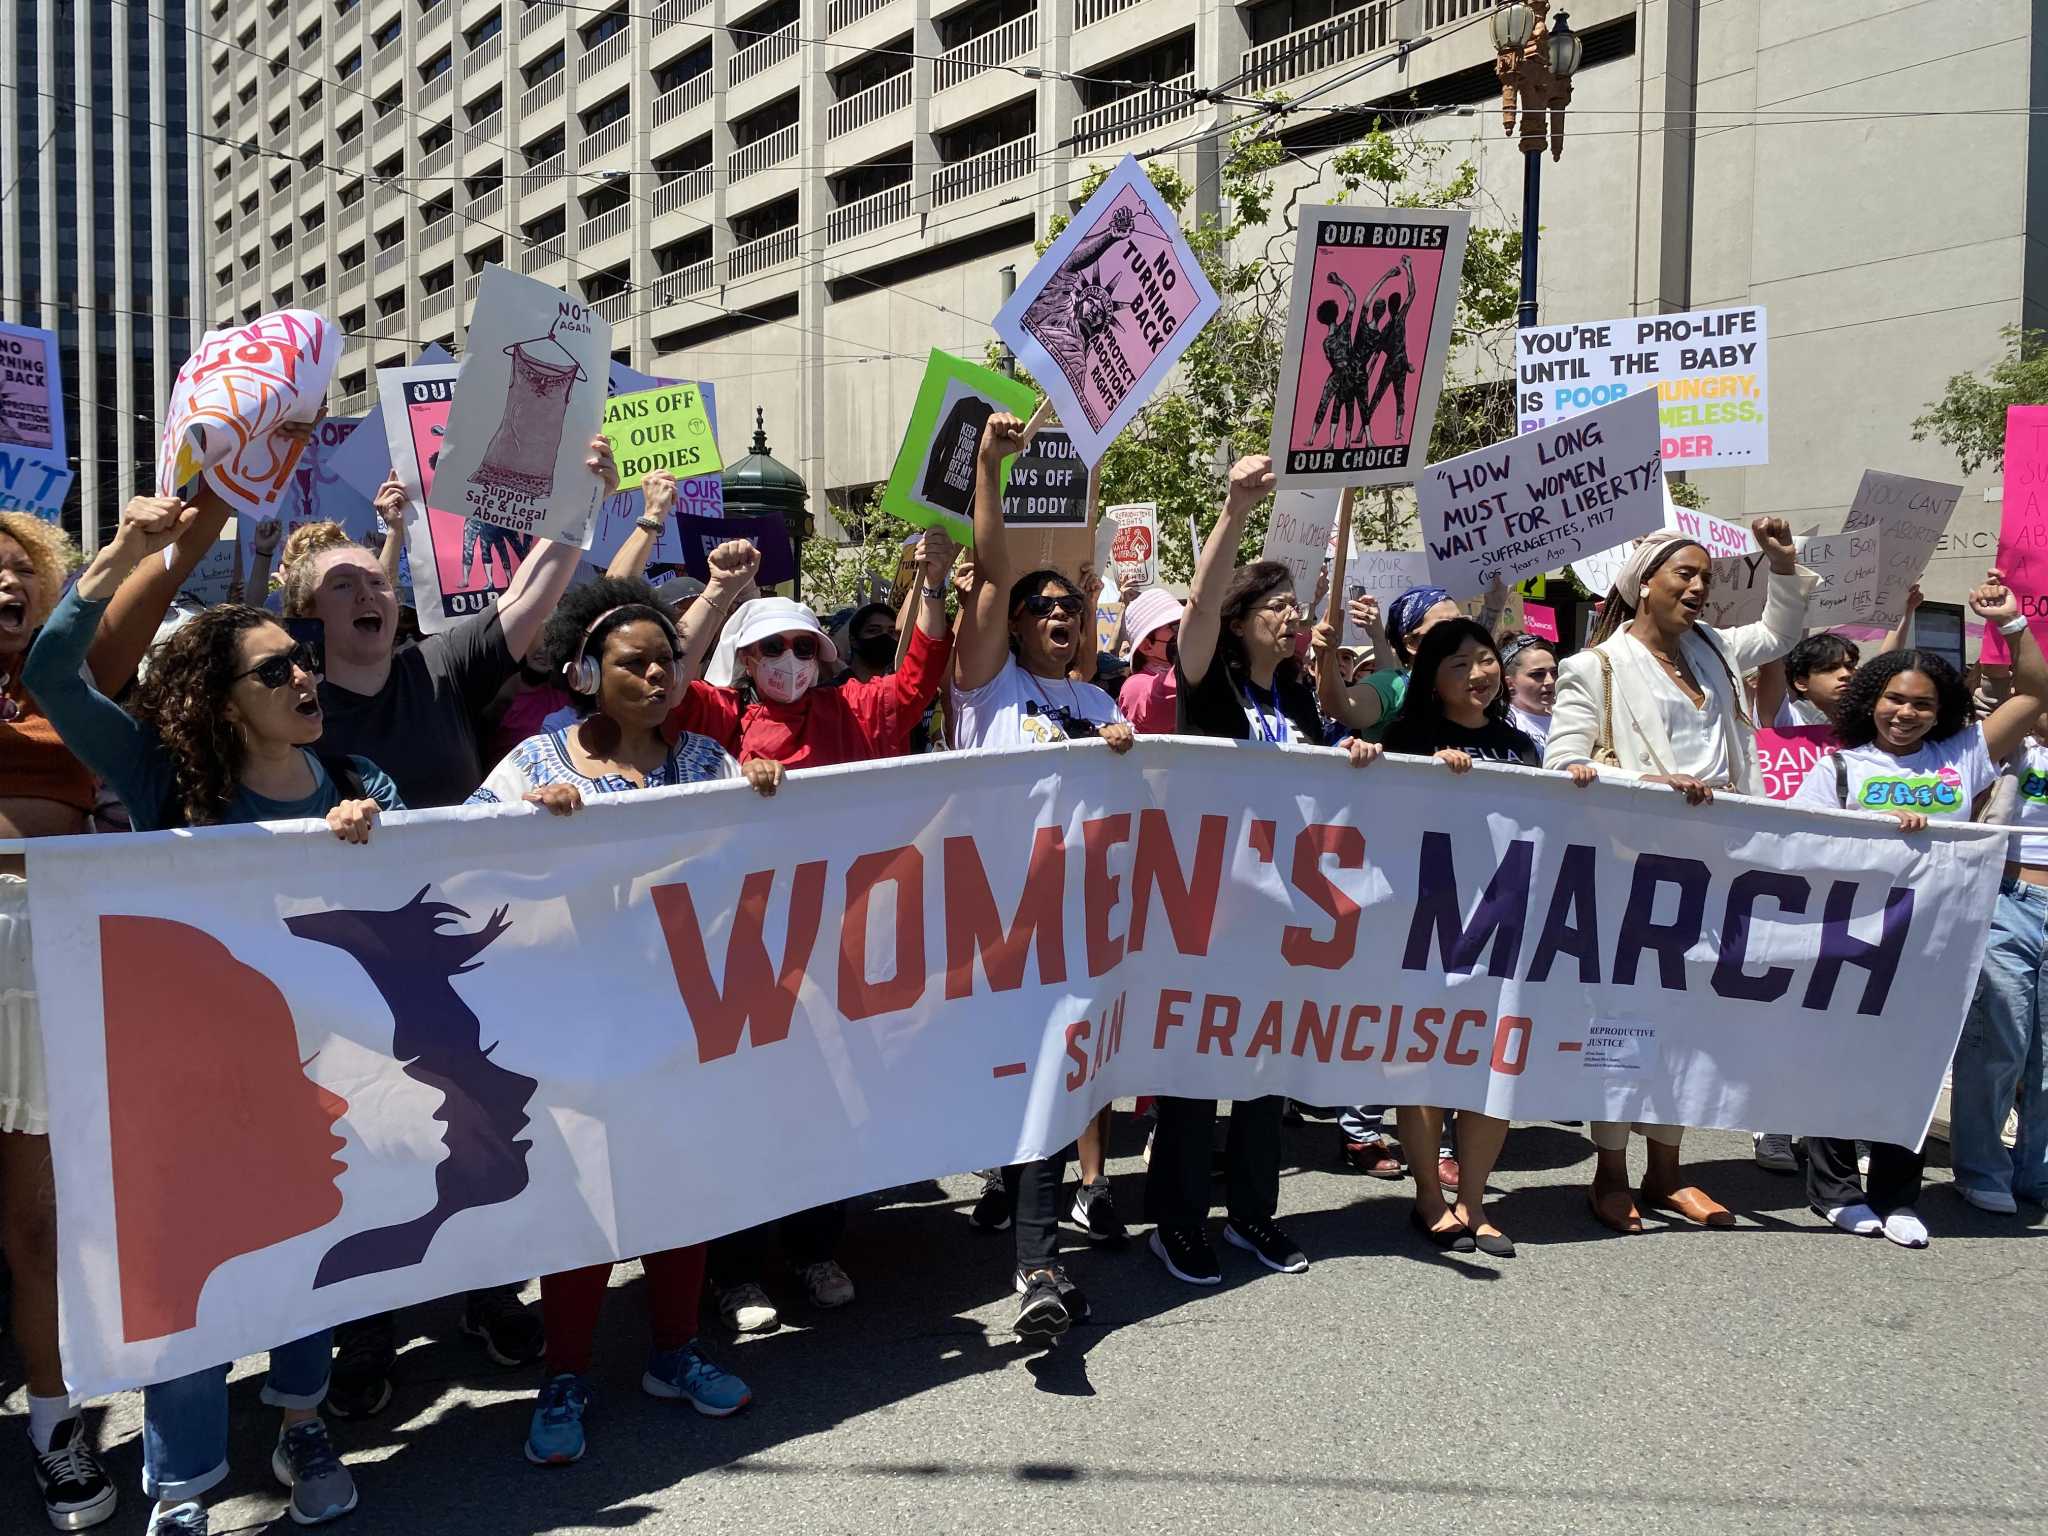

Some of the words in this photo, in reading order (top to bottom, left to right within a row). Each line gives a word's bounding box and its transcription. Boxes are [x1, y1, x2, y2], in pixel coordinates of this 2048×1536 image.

[1324, 224, 1365, 245] OUR
[1372, 227, 1442, 248] BODIES
[1153, 249, 1176, 291] NO
[1122, 239, 1177, 336] TURNING
[559, 302, 591, 323] NOT
[1131, 292, 1165, 354] BACK
[560, 321, 591, 334] AGAIN
[1520, 325, 1612, 356] YOU'RE
[1637, 310, 1757, 345] PRO-LIFE
[1090, 334, 1126, 399] ABORTION
[1104, 329, 1136, 386] PROTECT
[1520, 358, 1591, 385] UNTIL
[1610, 351, 1660, 376] THE
[1680, 342, 1758, 370] BABY
[5, 370, 45, 387] BACK
[1091, 366, 1117, 411] RIGHTS
[655, 391, 695, 413] OFF
[1520, 391, 1544, 414] IS
[1555, 383, 1629, 411] POOR
[630, 424, 676, 446] OUR
[960, 422, 977, 439] KEEP
[957, 434, 975, 452] YOUR
[1038, 441, 1077, 459] YOUR
[1537, 422, 1604, 465] LONG
[622, 446, 700, 477] BODIES
[952, 448, 972, 464] LAWS
[1294, 452, 1337, 471] OUR
[1342, 448, 1403, 470] CHOICE
[949, 459, 962, 473] OFF
[961, 465, 973, 478] MY
[1007, 468, 1038, 486] AWS
[1045, 469, 1073, 487] OFF
[684, 480, 721, 499] OUR
[943, 472, 970, 491] UTERUS
[466, 490, 495, 508] Safe
[498, 502, 508, 512] &
[512, 504, 547, 521] Legal
[482, 483, 536, 506] Support
[1002, 497, 1020, 514] MY
[1027, 497, 1067, 514] BODY
[1443, 492, 1508, 532] MUST
[1526, 456, 1607, 503] WOMEN
[473, 507, 533, 531] Abortion
[1274, 513, 1296, 544] PRO
[1587, 508, 1615, 529] 1917
[1430, 525, 1488, 562] WAIT
[1504, 505, 1551, 538] FOR
[1676, 511, 1701, 537] MY
[1710, 520, 1748, 552] BODY
[1369, 556, 1405, 574] YOUR
[1510, 555, 1540, 575] Years
[1547, 547, 1566, 562] Ago
[650, 808, 1366, 1064] WOMEN'S
[1402, 831, 1916, 1017] MARCH
[1065, 990, 1127, 1093] SAN
[1153, 988, 1533, 1076] FRANCISCO
[1587, 1038, 1625, 1048] JUSTICE
[1589, 1026, 1656, 1038] REPRODUCTIVE
